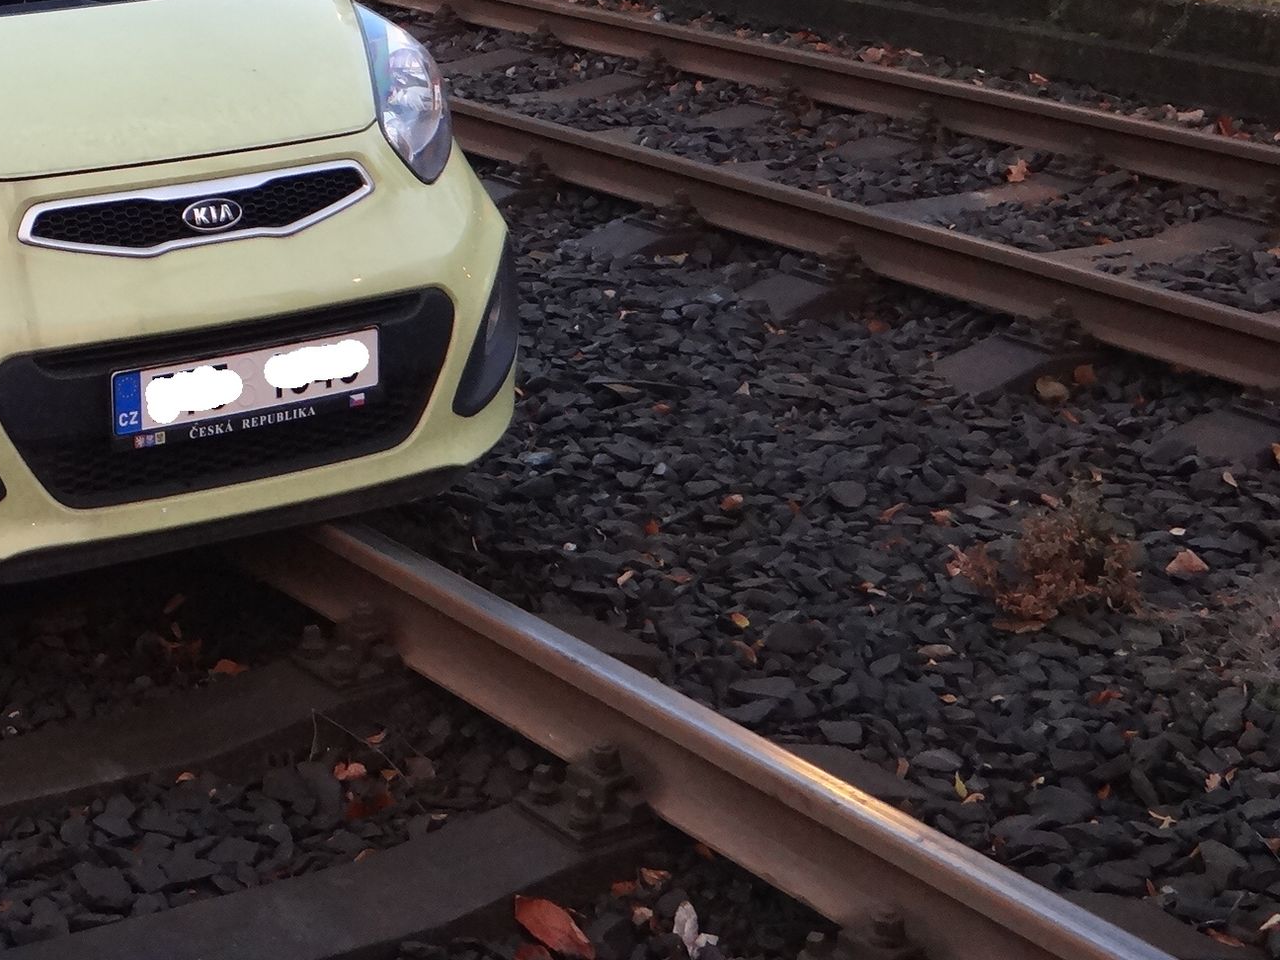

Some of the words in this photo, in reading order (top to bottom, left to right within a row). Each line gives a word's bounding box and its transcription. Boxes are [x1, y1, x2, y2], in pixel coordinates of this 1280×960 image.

[193, 204, 234, 225] KIA
[118, 411, 138, 427] CZ
[189, 419, 233, 439] ČESKÁ
[242, 406, 316, 429] REPUBLIKA
